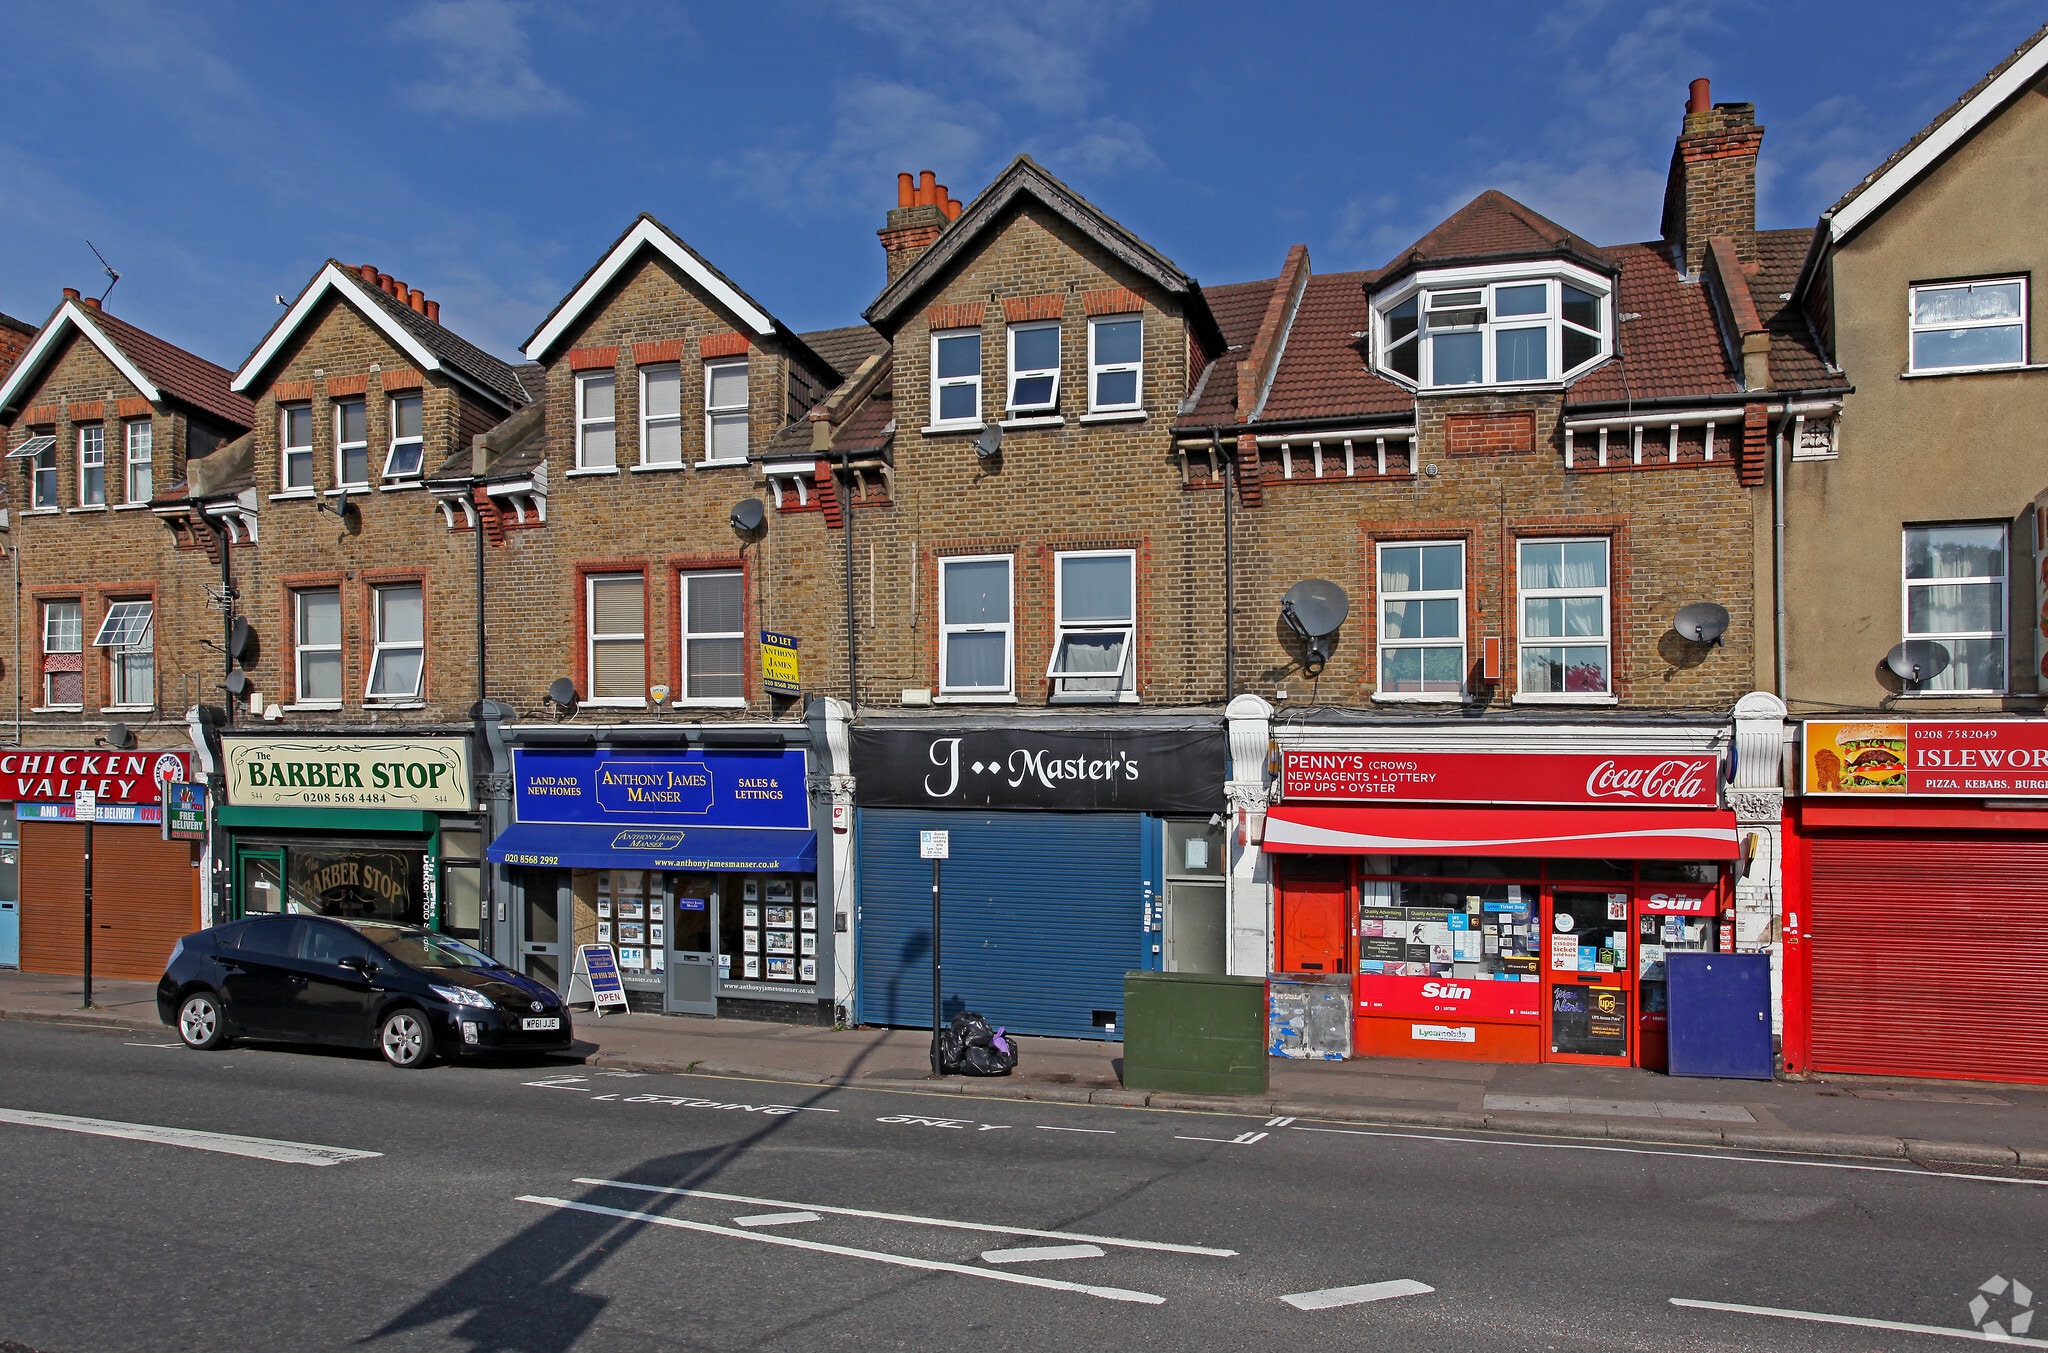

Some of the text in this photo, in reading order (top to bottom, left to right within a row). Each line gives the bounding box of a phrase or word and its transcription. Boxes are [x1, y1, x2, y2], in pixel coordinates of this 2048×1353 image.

[767, 634, 792, 646] TO LET
[764, 645, 796, 659] ANTHONY
[769, 658, 792, 669] JAMES
[766, 668, 796, 680] MANSER
[1915, 730, 1997, 739] 0208 7582049
[256, 751, 271, 760] The
[1, 755, 148, 776] CHICKEN
[1007, 749, 1139, 788] Master's
[1288, 755, 1417, 771] PENNY'S (CROWS)
[248, 762, 447, 789] BARBER STOP
[530, 776, 577, 786] LAND AND
[602, 770, 706, 789] ANTHONY JAMES
[1288, 771, 1436, 783] NEWSAGENTS LOTTERY
[1586, 760, 1709, 798] Coca-Cola
[17, 778, 137, 799] VALLEY
[738, 778, 778, 789] SALES &
[1288, 782, 1395, 793] TOP UPS OYSTER
[251, 792, 263, 800] 544
[527, 786, 581, 797] NEW HOMES
[627, 787, 681, 803] MANSER
[735, 789, 783, 800] LETTINGS
[303, 793, 386, 803] 0208 568 4484
[435, 795, 447, 804] 544
[105, 808, 135, 820] DELIVERY
[180, 811, 195, 821] FREE
[172, 820, 203, 831] DELIVERY
[505, 854, 558, 865] 020 8568 2992
[654, 858, 779, 870] www.anthonyjamesmanser.co.uk
[302, 862, 359, 903] BARBER
[363, 864, 403, 904] STOP
[1647, 893, 1702, 911] Sun
[724, 983, 815, 995] www.anthonyjamesmanser.co.uk
[1421, 982, 1472, 1000] Sun
[598, 993, 620, 1003] OPEN
[1600, 1000, 1614, 1010] ups
[526, 1018, 555, 1028] WP61 JJE
[591, 1094, 799, 1116] LOADING
[875, 1117, 1012, 1130] ONLY
